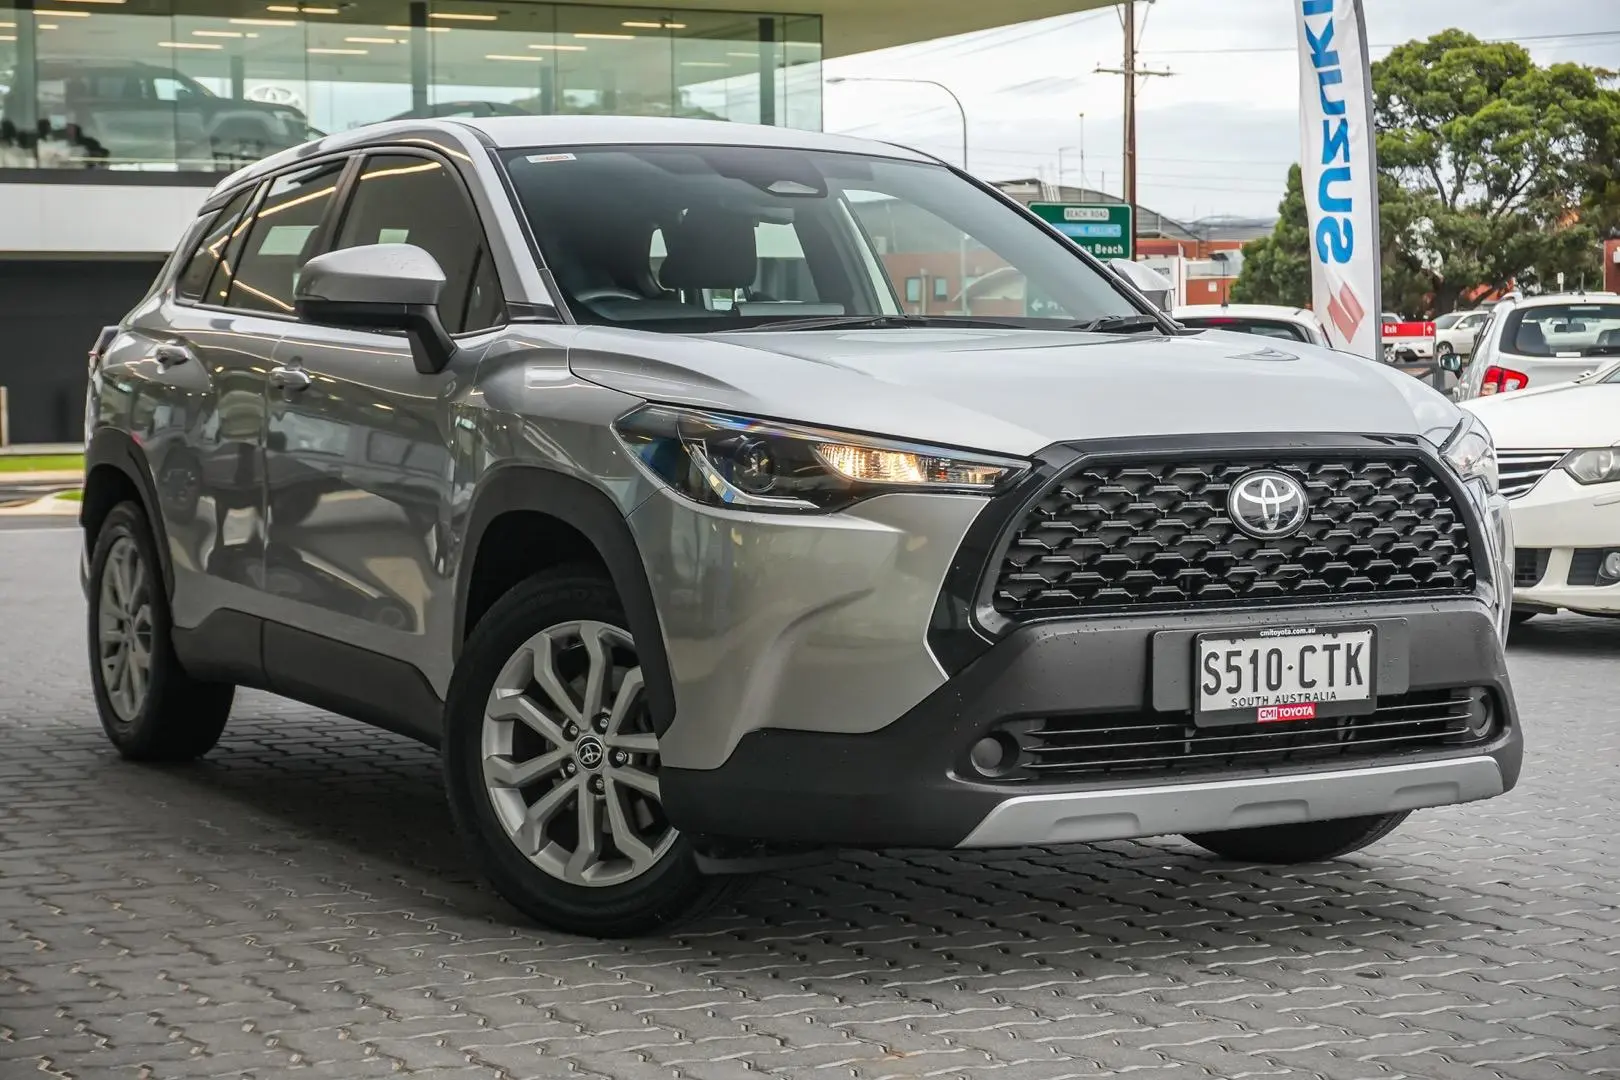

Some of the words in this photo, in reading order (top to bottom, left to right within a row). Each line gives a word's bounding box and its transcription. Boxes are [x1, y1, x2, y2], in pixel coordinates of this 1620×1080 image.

[1066, 209, 1087, 218] BEACH
[1091, 209, 1108, 218] ROAD
[1095, 243, 1123, 254] Beach
[1384, 324, 1397, 334] Exit
[1260, 627, 1316, 638] cmitoyota.com.au
[1231, 696, 1269, 708] SOUTH
[1274, 691, 1337, 704] AUSTRALIA
[1259, 708, 1277, 719] CMI
[1279, 706, 1314, 718] TOYOTA
